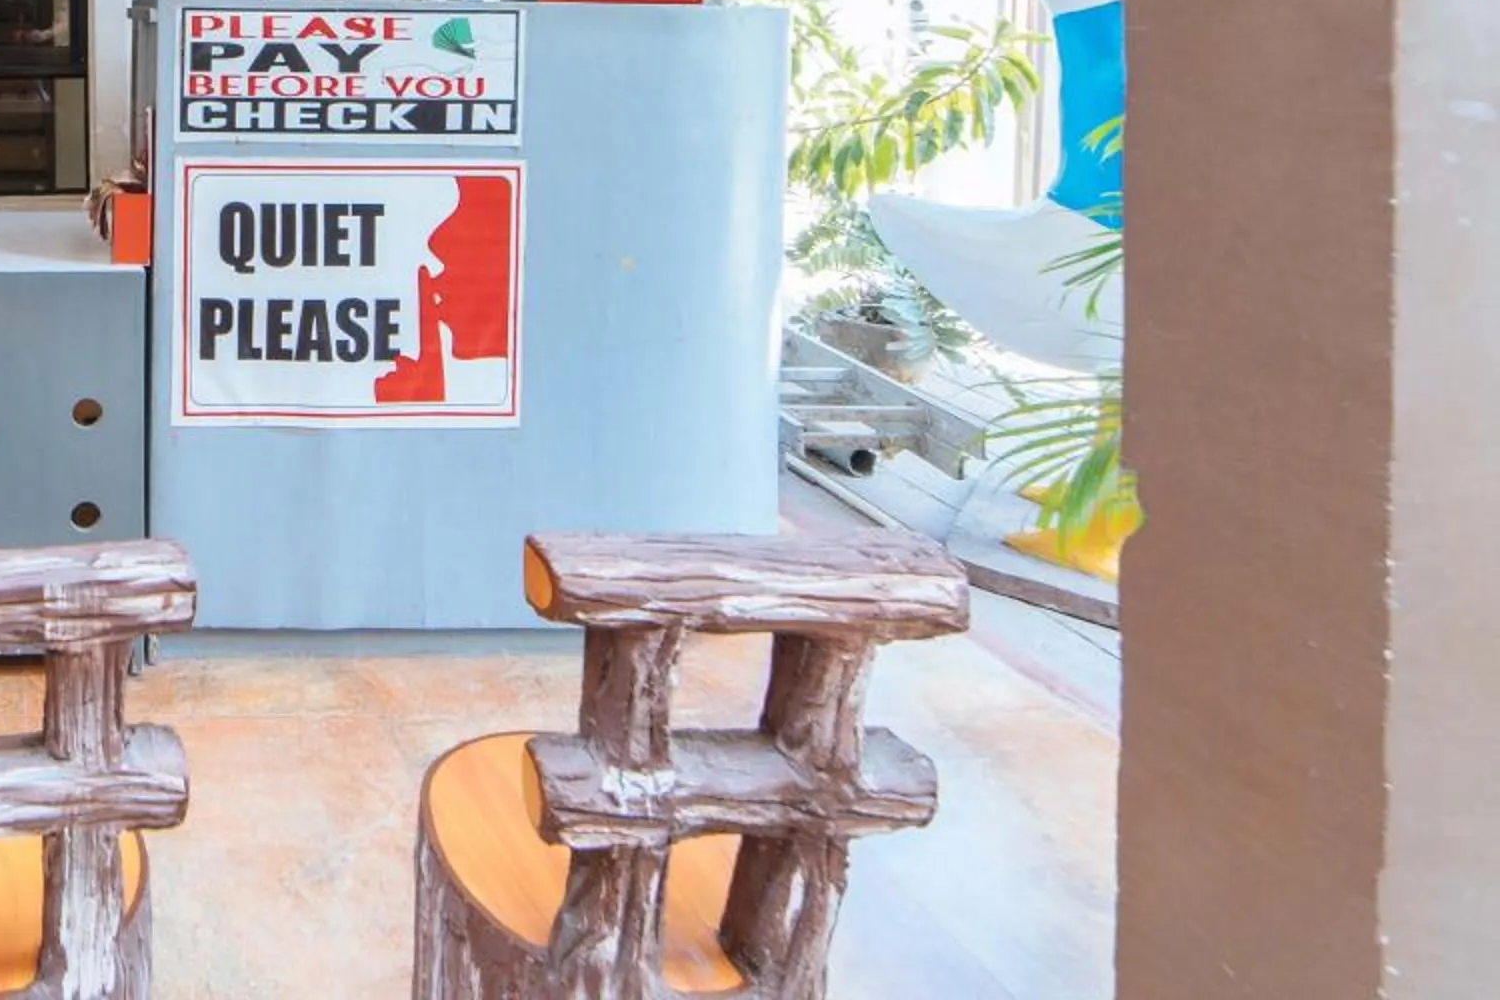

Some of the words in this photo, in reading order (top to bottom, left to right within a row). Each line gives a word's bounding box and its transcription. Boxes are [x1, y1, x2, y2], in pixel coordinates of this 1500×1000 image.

[190, 15, 414, 40] PLEASE
[189, 42, 384, 73] PAY
[188, 75, 367, 97] BEFORE
[384, 76, 486, 99] YOU
[186, 101, 418, 131] CHECK
[444, 103, 512, 132] IN
[219, 201, 385, 275] QUIET
[200, 298, 401, 362] PLEASE
